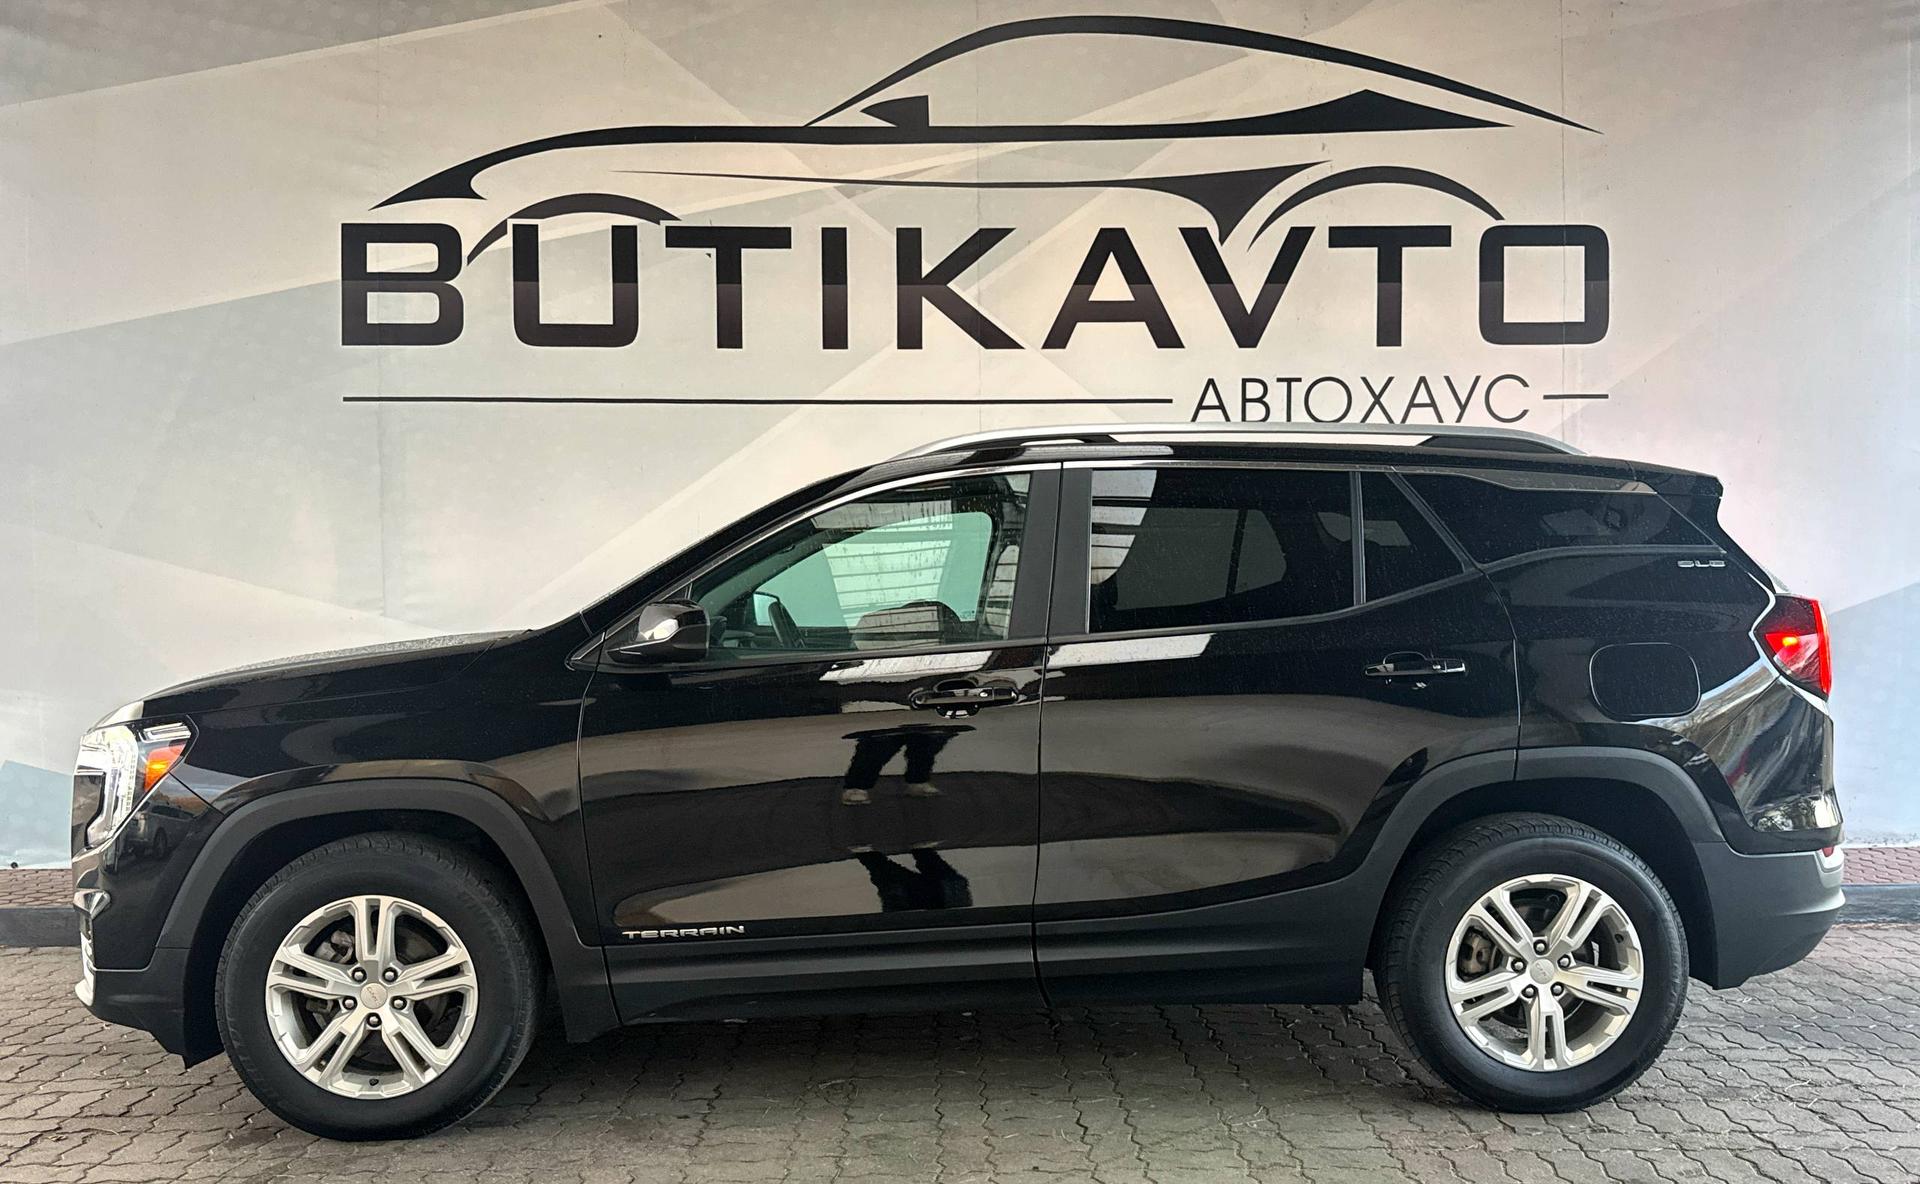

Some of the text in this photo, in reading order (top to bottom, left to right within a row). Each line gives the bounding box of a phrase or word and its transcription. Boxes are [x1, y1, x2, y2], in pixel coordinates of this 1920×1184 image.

[341, 222, 1610, 350] BUTIKAVTO
[1190, 373, 1530, 424] АВТОХАУС
[621, 925, 745, 940] TERRAIN
